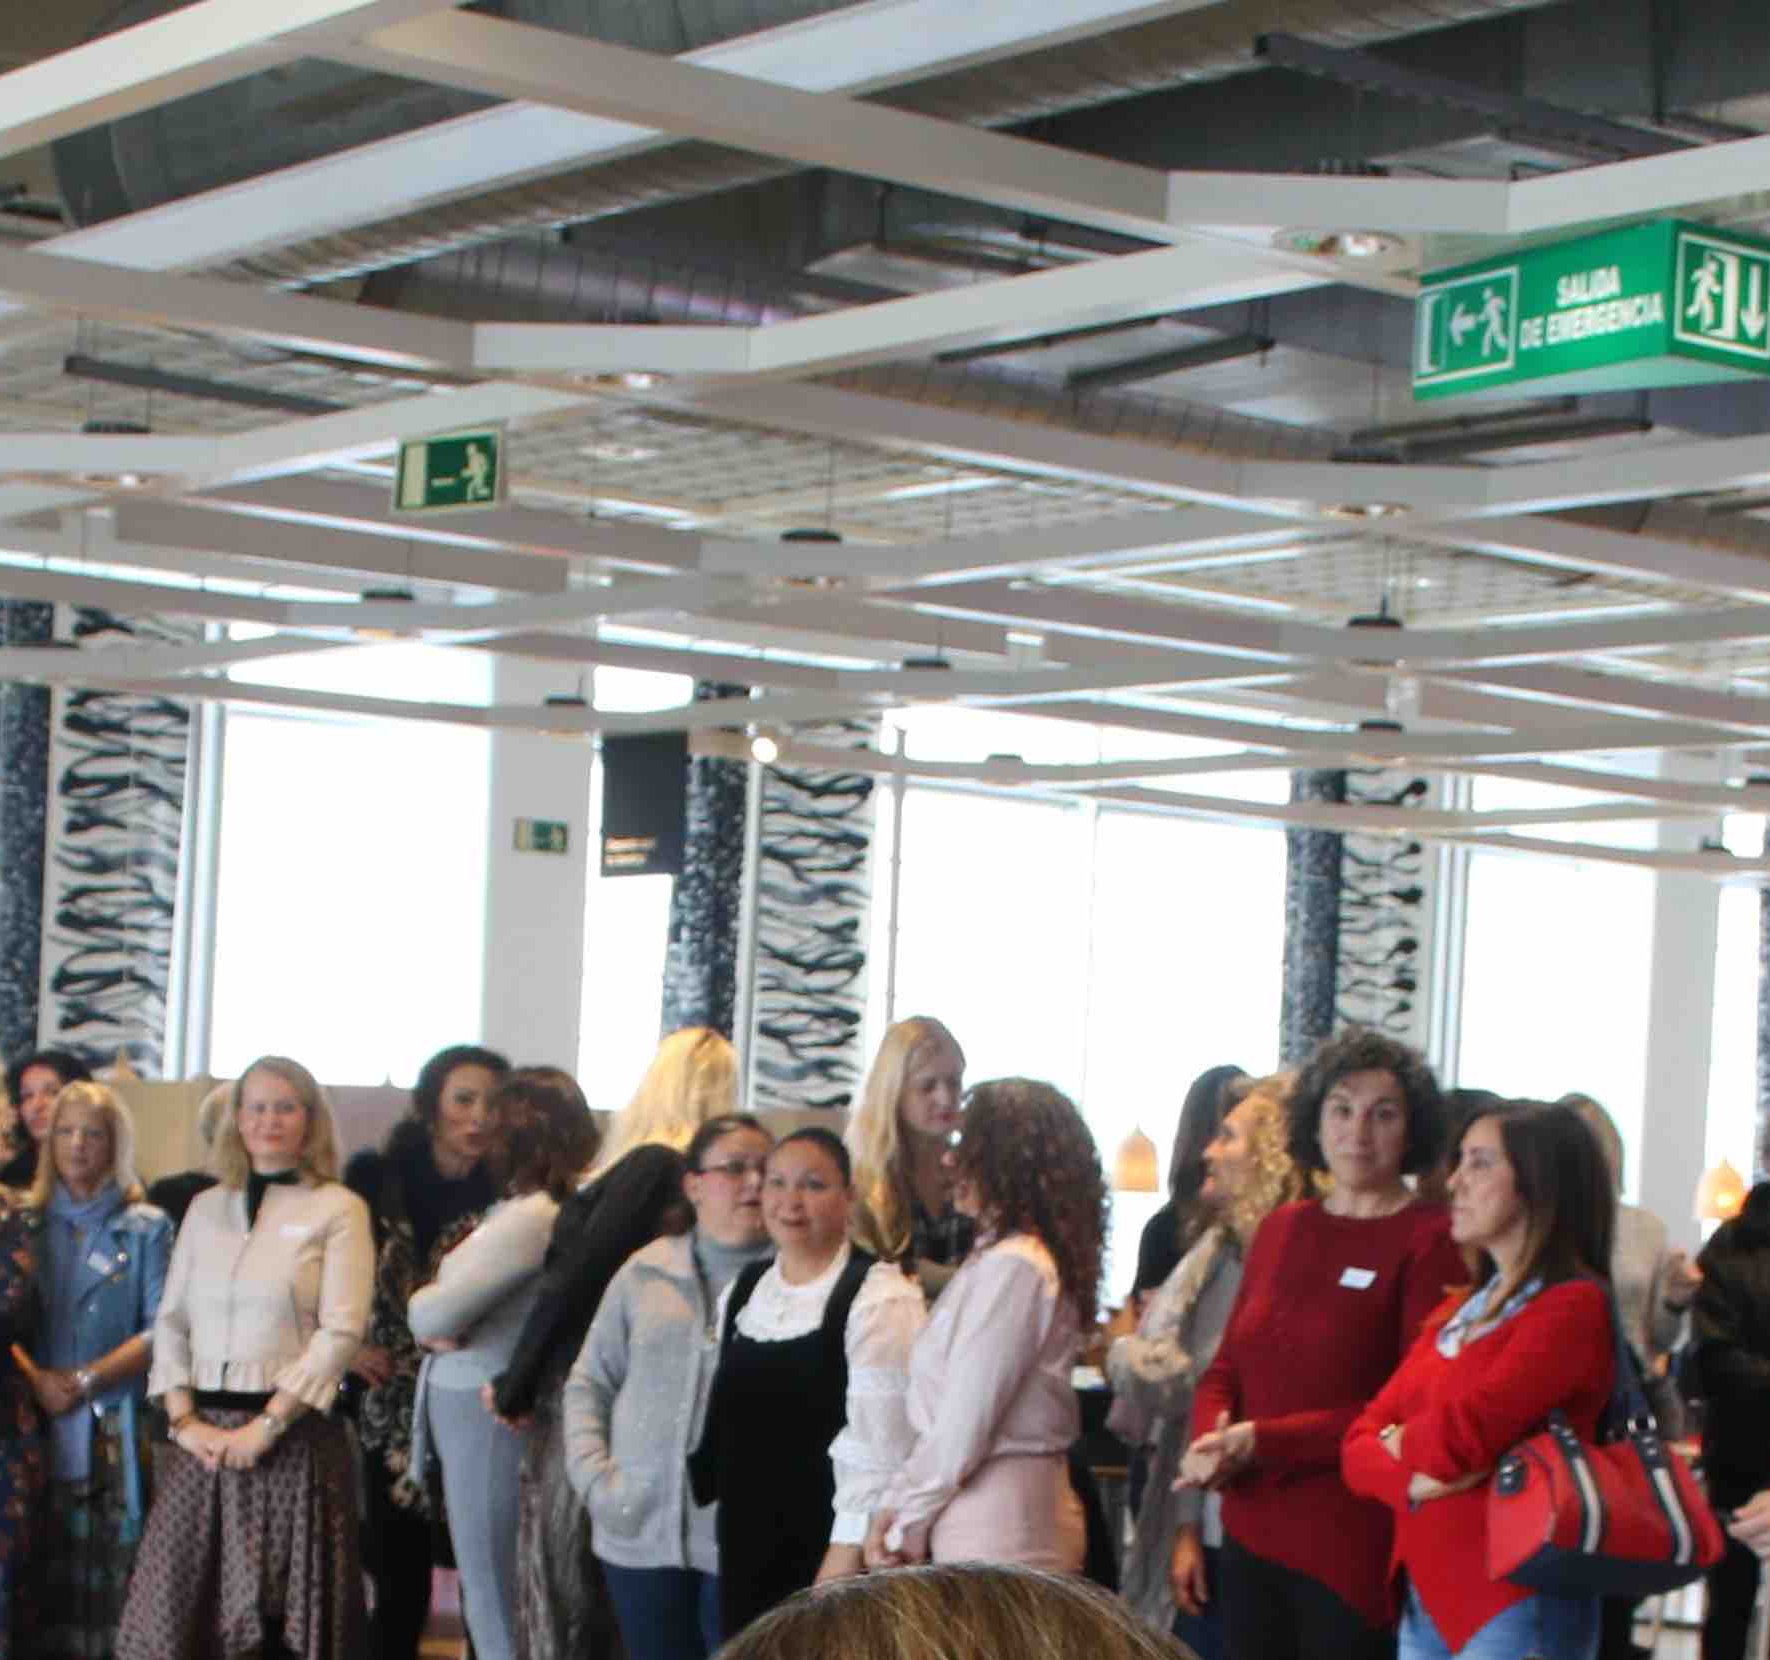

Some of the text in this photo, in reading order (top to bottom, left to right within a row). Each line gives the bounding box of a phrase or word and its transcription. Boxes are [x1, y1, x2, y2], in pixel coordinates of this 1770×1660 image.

[1556, 265, 1622, 308] SALIDA
[1519, 292, 1665, 351] DE EMERGENCIA
